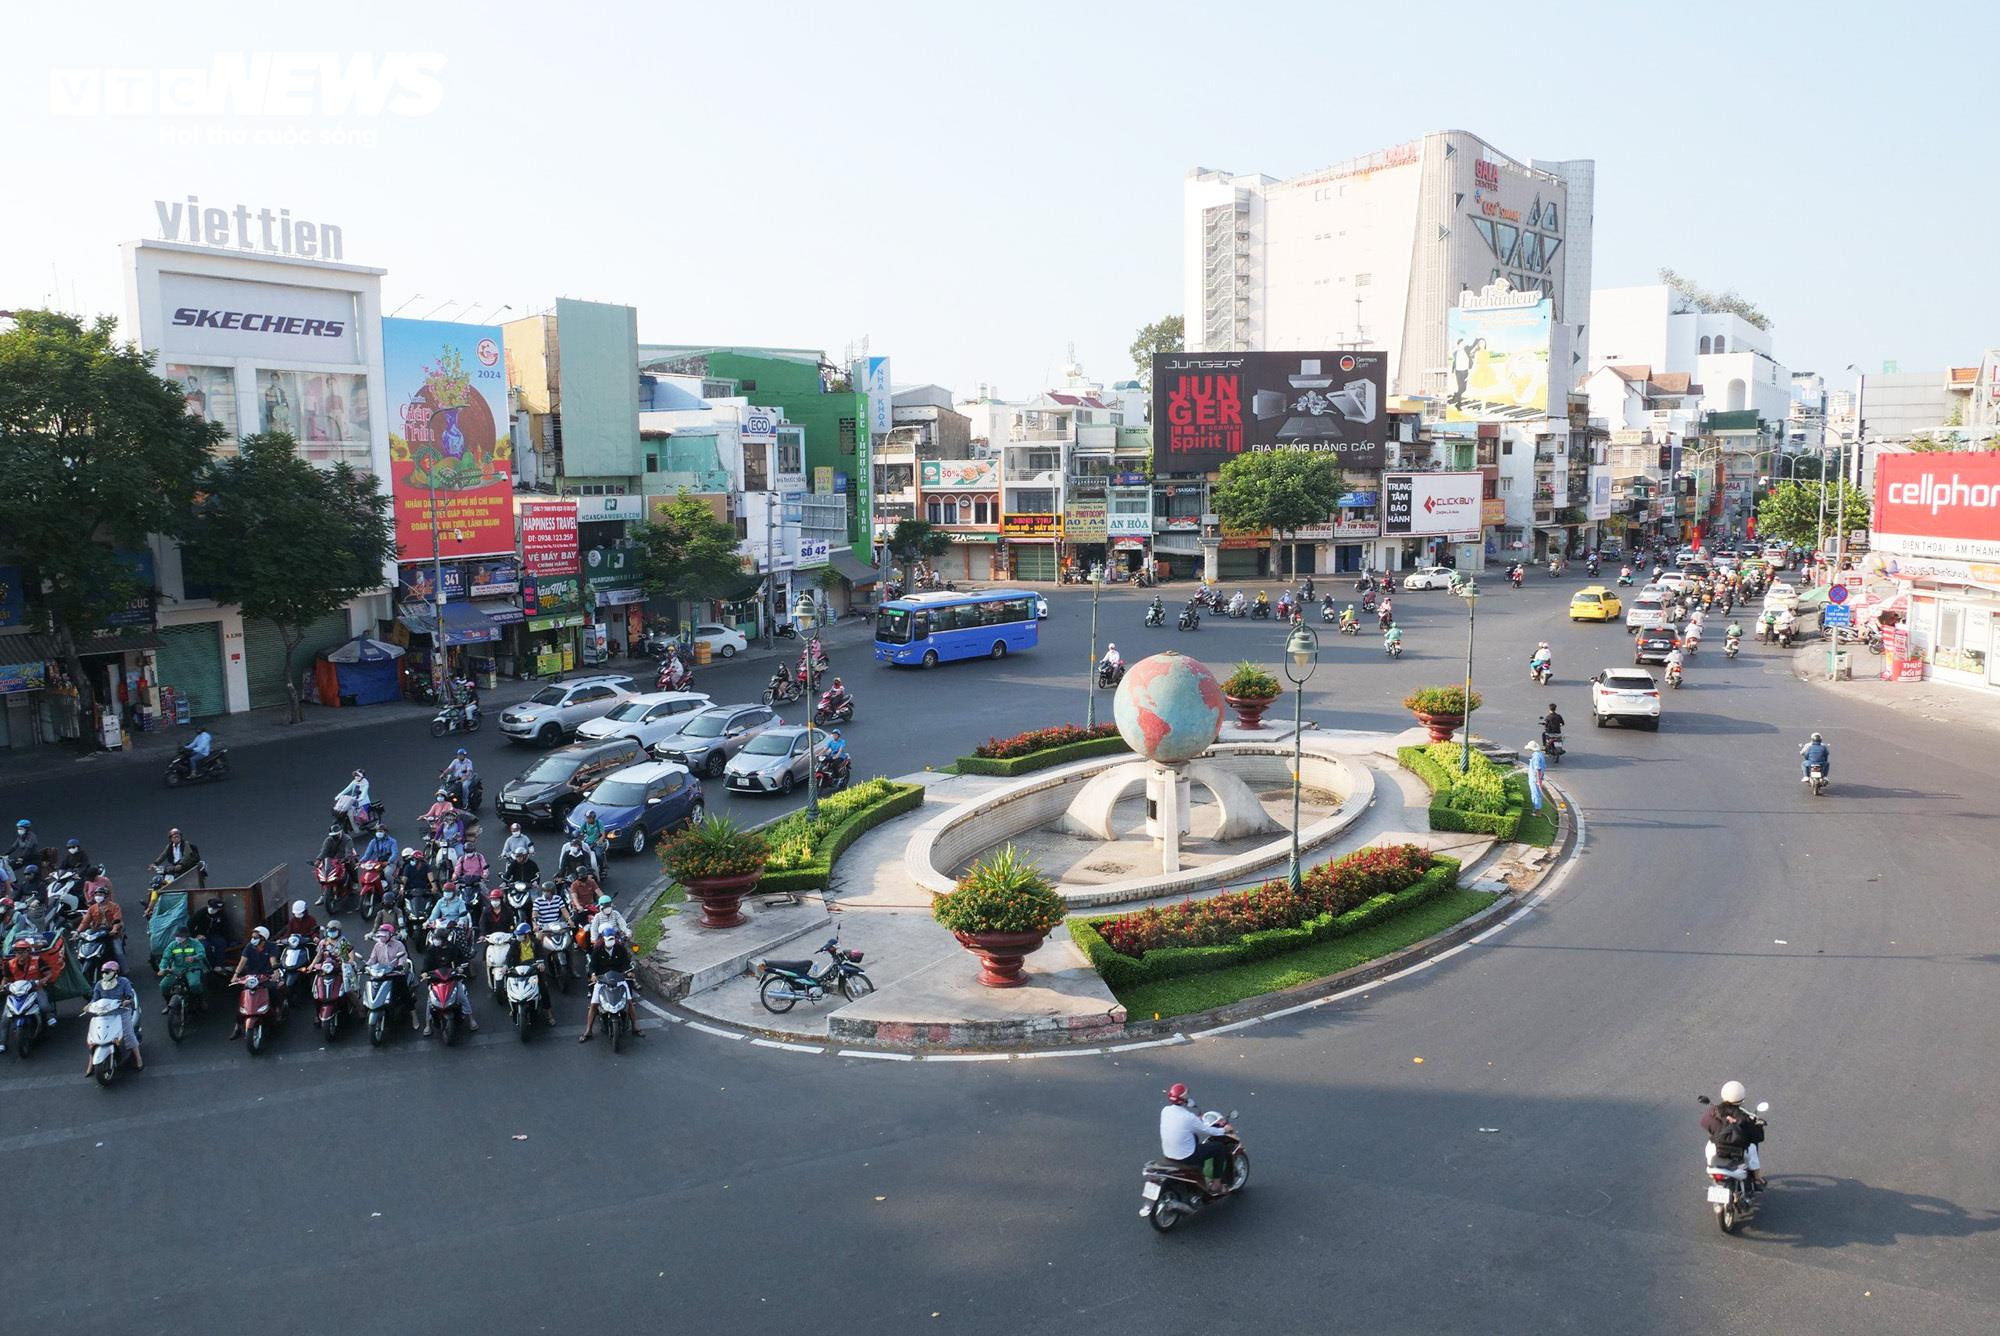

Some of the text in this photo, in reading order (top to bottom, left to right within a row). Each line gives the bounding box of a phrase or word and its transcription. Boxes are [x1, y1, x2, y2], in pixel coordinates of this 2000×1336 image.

[1475, 159, 1499, 183] GALA
[155, 195, 343, 259] viettien
[172, 307, 345, 338] SKECHERS
[1165, 360, 1242, 369] JUNGER
[477, 370, 501, 379] 2024
[1168, 375, 1238, 400] JUN
[877, 400, 885, 427] KHOA
[1168, 399, 1242, 425] GER
[751, 420, 768, 431] ECO
[1252, 444, 1272, 453] GIA
[942, 470, 960, 478] 50%
[1388, 483, 1412, 491] TRUNG
[478, 496, 487, 505] CHÍ
[1391, 491, 1408, 501] TÂM
[523, 516, 576, 531] HAPPINESS TRAVEL
[1110, 517, 1149, 528] AN HÒA
[1388, 513, 1410, 523] HÀNH
[541, 551, 558, 561] MÁY
[561, 551, 576, 560] BAY
[801, 544, 826, 557] SỐ 42
[444, 574, 459, 586] 341
